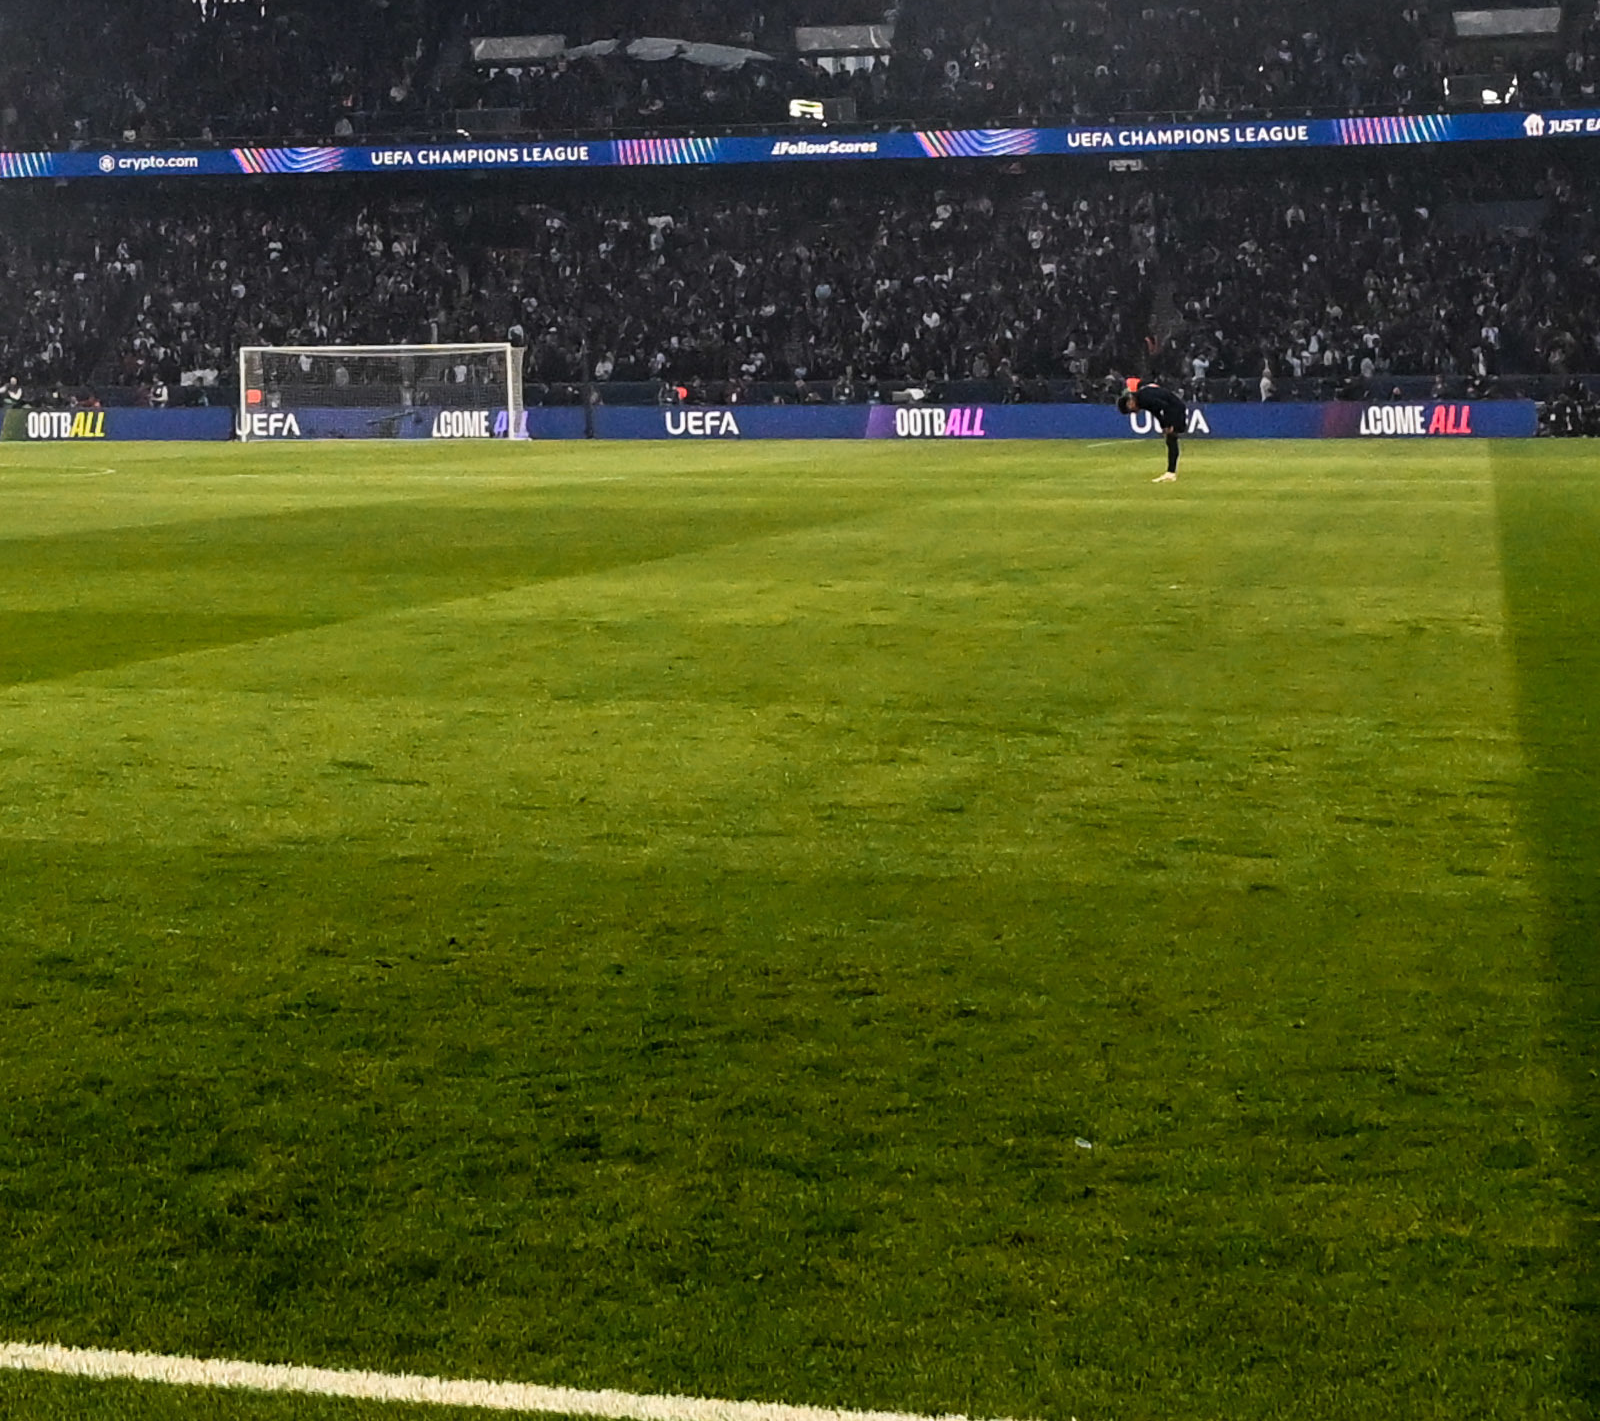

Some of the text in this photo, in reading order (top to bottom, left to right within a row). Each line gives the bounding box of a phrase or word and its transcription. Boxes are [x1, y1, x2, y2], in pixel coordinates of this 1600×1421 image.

[1548, 117, 1583, 133] JUST
[1067, 125, 1309, 148] UEFA CHAMPIONS LEAGUE
[118, 155, 198, 171] crypto.com
[371, 146, 589, 167] UEFA CHAMPIONS LEAGUE
[665, 411, 740, 435] UEFA
[1427, 405, 1472, 435] ALL
